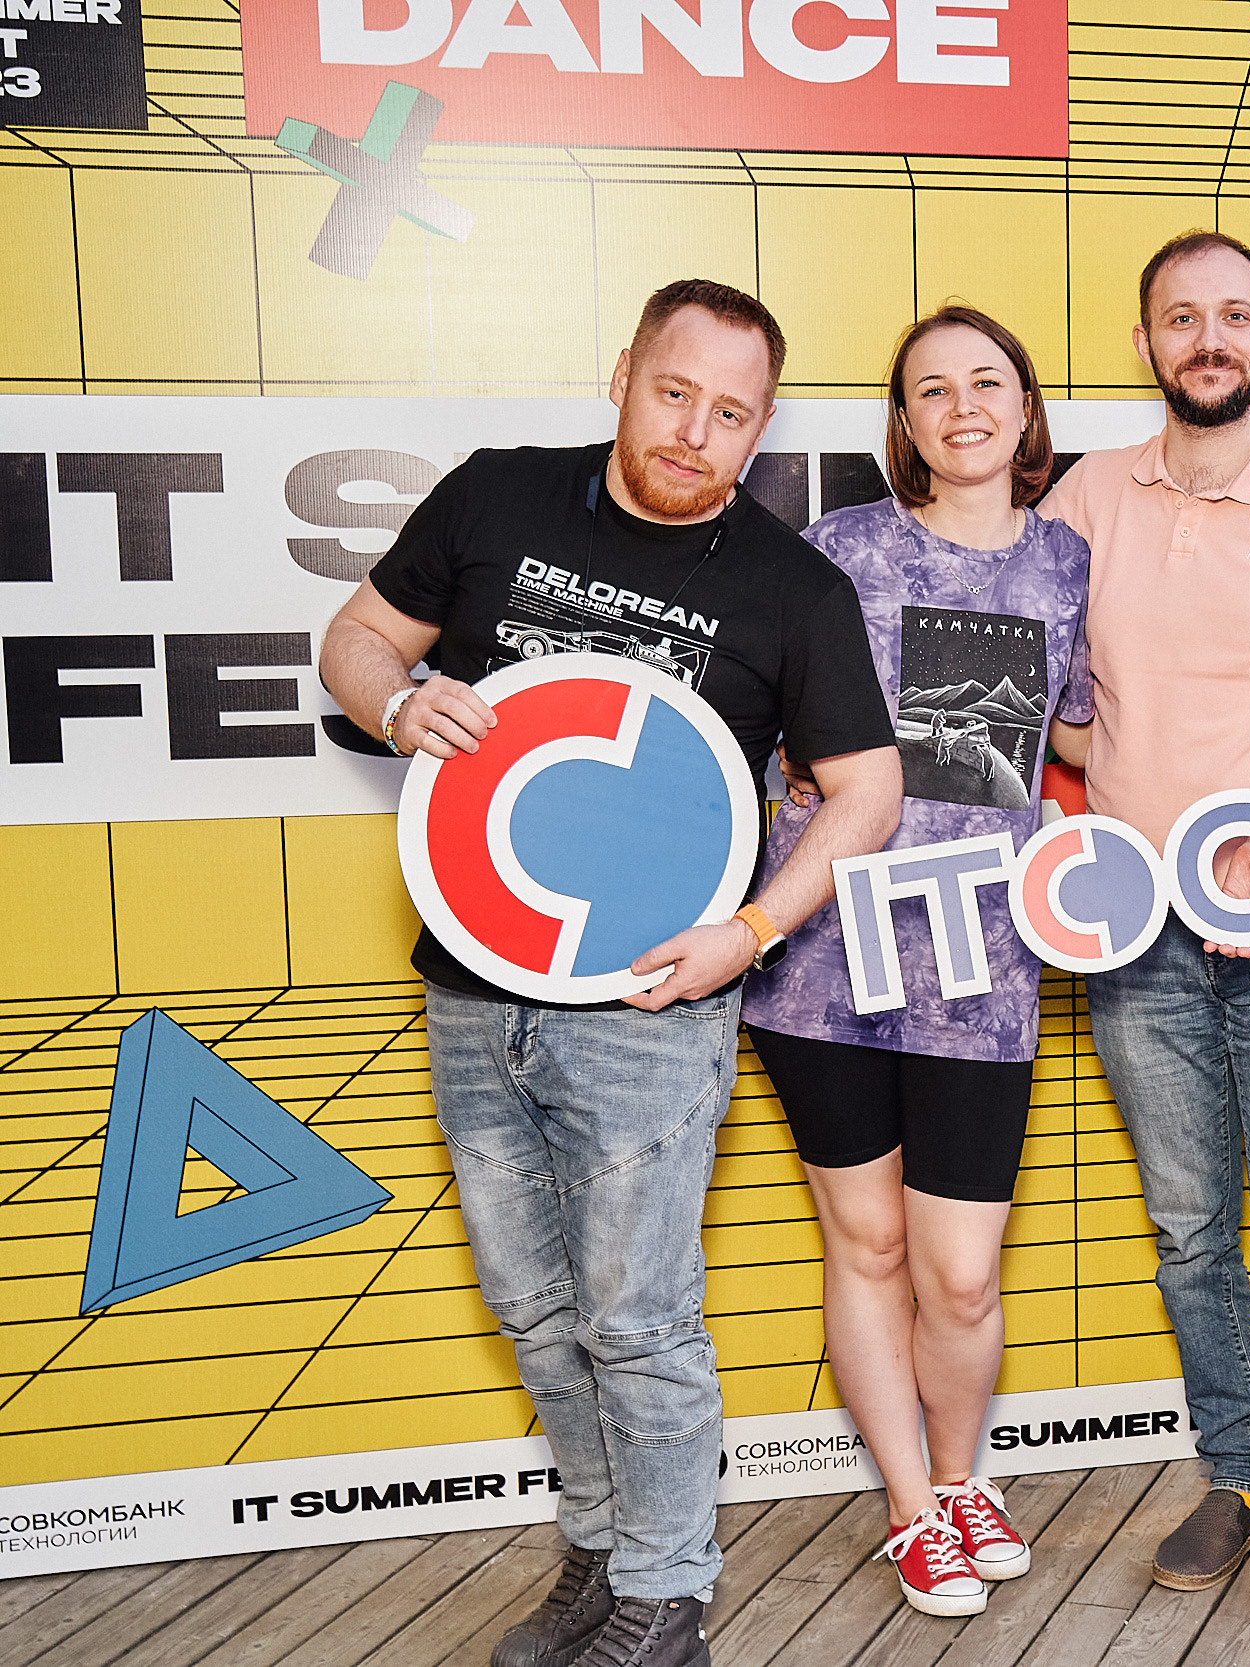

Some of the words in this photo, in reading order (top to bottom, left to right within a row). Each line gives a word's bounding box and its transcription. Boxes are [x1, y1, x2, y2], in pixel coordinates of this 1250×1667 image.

[0, 0, 122, 24] MER
[319, 0, 1010, 86] DANCE
[0, 66, 42, 98] 3
[0, 451, 224, 582] IT
[515, 574, 550, 594] TIME
[552, 588, 624, 618] MACHINE
[517, 556, 719, 637] DELOREAN
[919, 617, 1034, 641] КАМЧАТКА
[735, 1433, 866, 1460] СОВКОМБА
[990, 1410, 1179, 1451] SUMMER
[736, 1455, 857, 1478] ТЕХНОЛОГИИ
[0, 1499, 185, 1534] СОВКОМБАНК
[232, 1495, 278, 1525] IT
[290, 1473, 506, 1518] SUMMER
